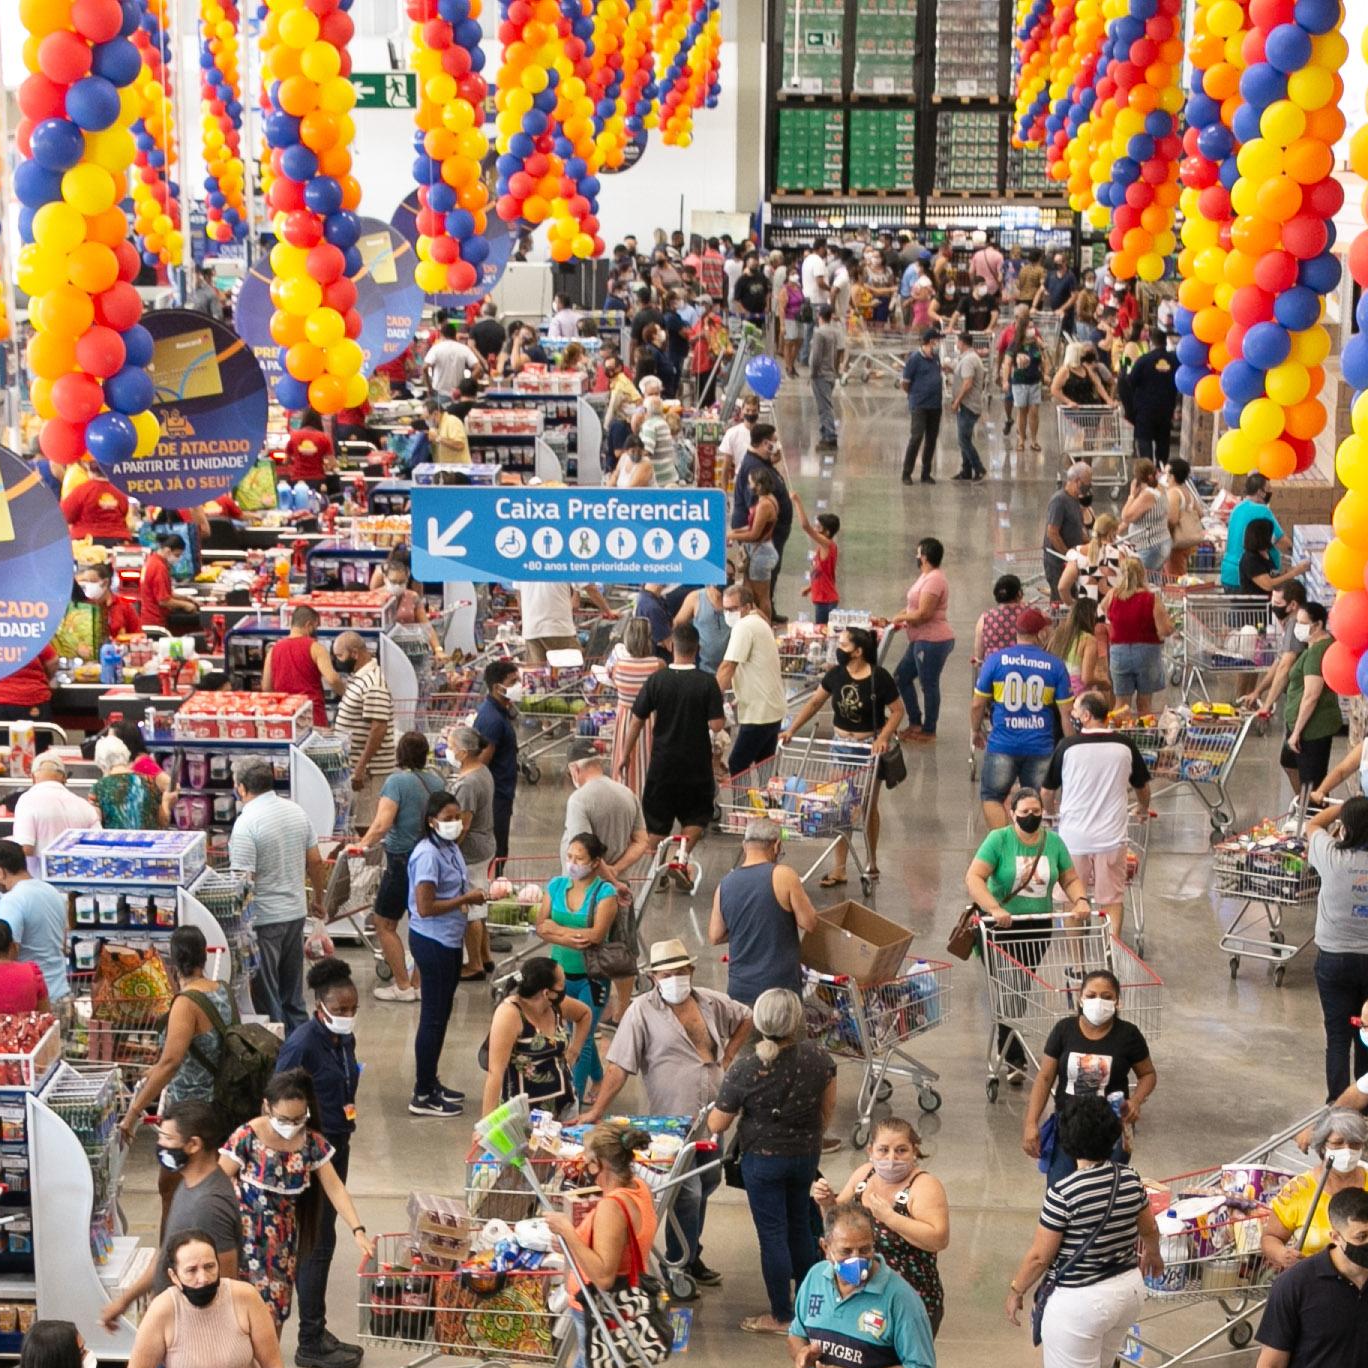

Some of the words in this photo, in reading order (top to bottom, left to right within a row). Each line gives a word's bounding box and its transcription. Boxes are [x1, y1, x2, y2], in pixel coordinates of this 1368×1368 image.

[159, 441, 178, 457] DE
[181, 439, 250, 455] ATACADO
[122, 462, 163, 474] PARTIR
[165, 461, 180, 472] DE
[127, 477, 162, 494] PEÇA
[166, 475, 183, 491] JÁ
[187, 477, 195, 489] O
[495, 498, 560, 520] Caixa
[568, 498, 711, 521] Preferencial
[523, 561, 542, 571] +80
[544, 562, 568, 571] anos
[570, 562, 589, 571] tem
[591, 561, 640, 573] prioridade
[643, 562, 682, 574] especial
[1001, 654, 1051, 670] Buckman
[1004, 671, 1045, 713] 00
